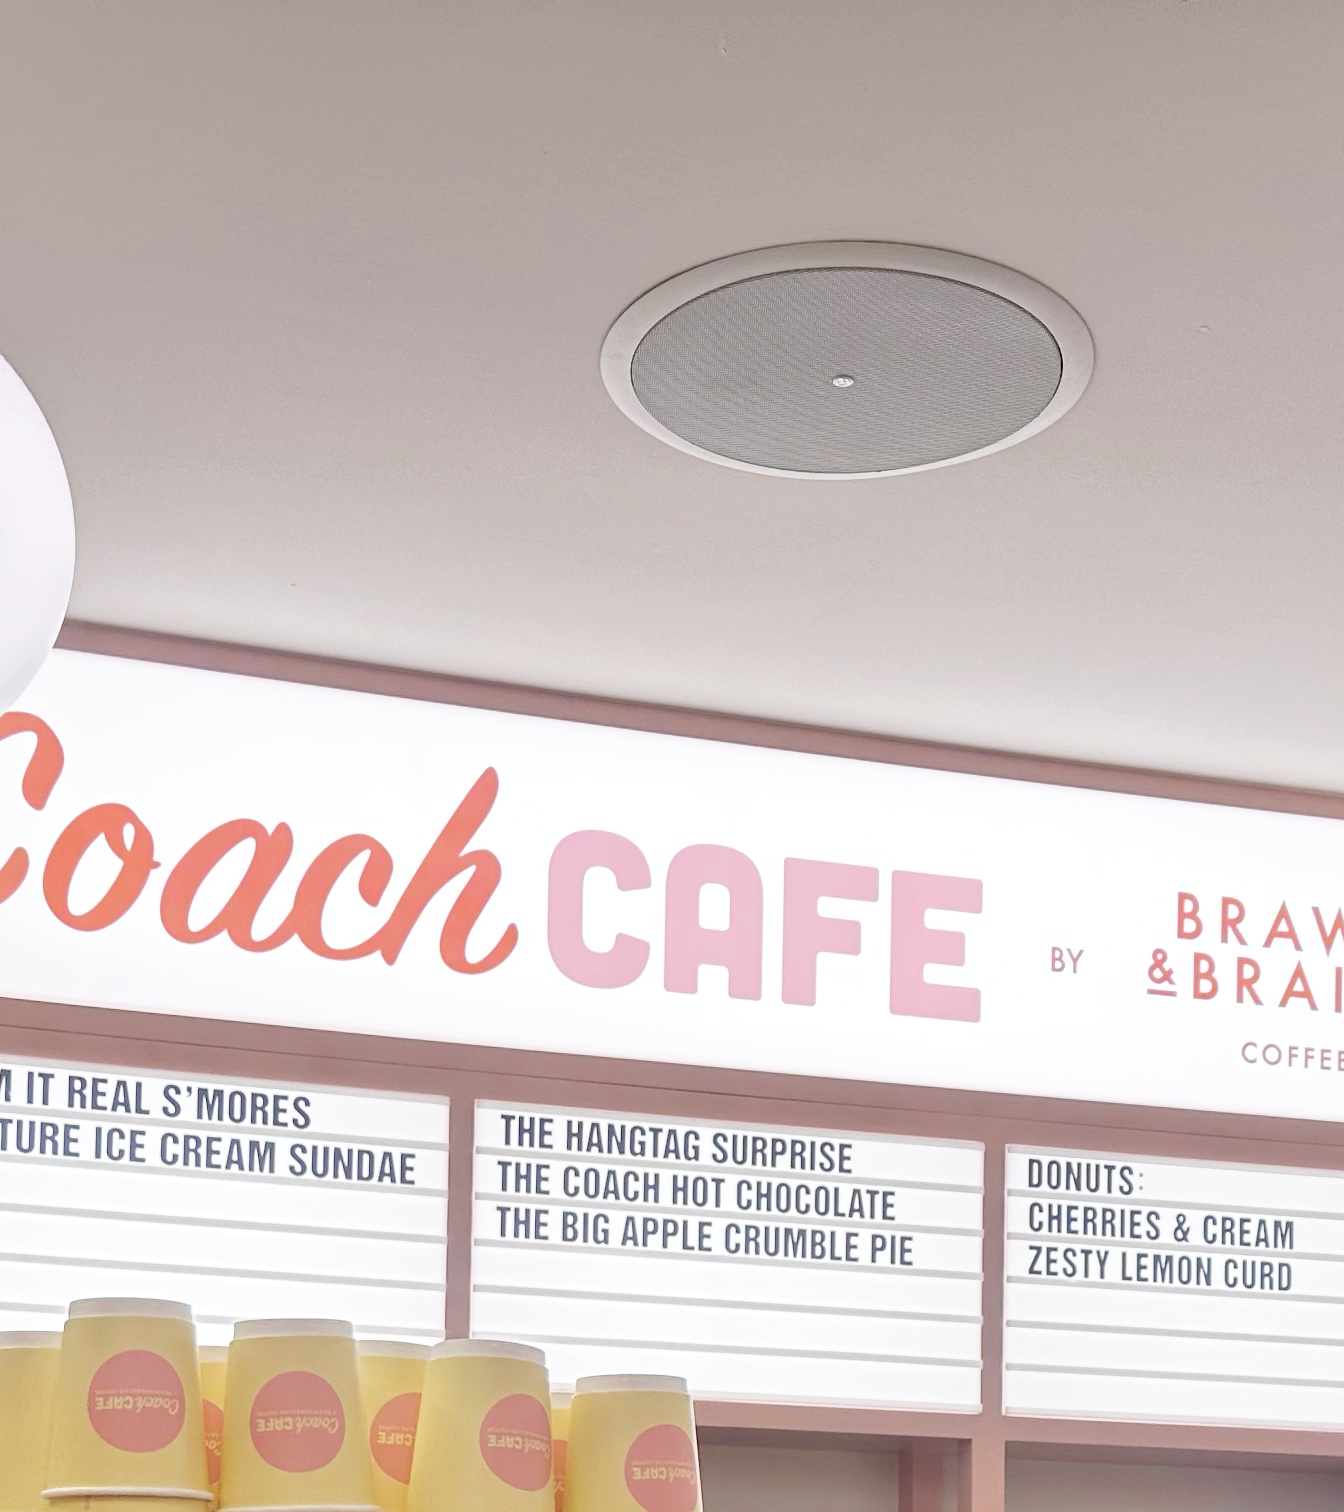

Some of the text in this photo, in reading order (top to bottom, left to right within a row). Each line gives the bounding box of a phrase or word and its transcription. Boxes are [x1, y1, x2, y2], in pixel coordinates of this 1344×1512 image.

[547, 829, 983, 1023] CAFE
[1050, 945, 1085, 976] BY
[27, 1071, 56, 1106] IT
[67, 1074, 151, 1116] REAL
[162, 1084, 312, 1130] S'MORES
[95, 1125, 146, 1164] ICE
[159, 1132, 276, 1175] CREAM
[288, 1143, 417, 1186] SUNDAE
[501, 1114, 853, 1175] THE HANGTAG SURPRISE
[497, 1160, 896, 1221] THE COACH HOT CHOCOLATE
[1028, 1158, 1144, 1196] DONUTS:
[496, 1206, 914, 1267] THE BIG APPLE CRUMBLE PIE
[1028, 1202, 1295, 1250] CHERRIES & CREAM
[1028, 1245, 1293, 1292] ZESTY LEMON CURD
[94, 1395, 179, 1415] Coach CAFE
[256, 1416, 339, 1434] Coach CAFE
[377, 1431, 414, 1446] CAFE
[487, 1433, 523, 1449] CAFE
[632, 1466, 667, 1480] CAFE
